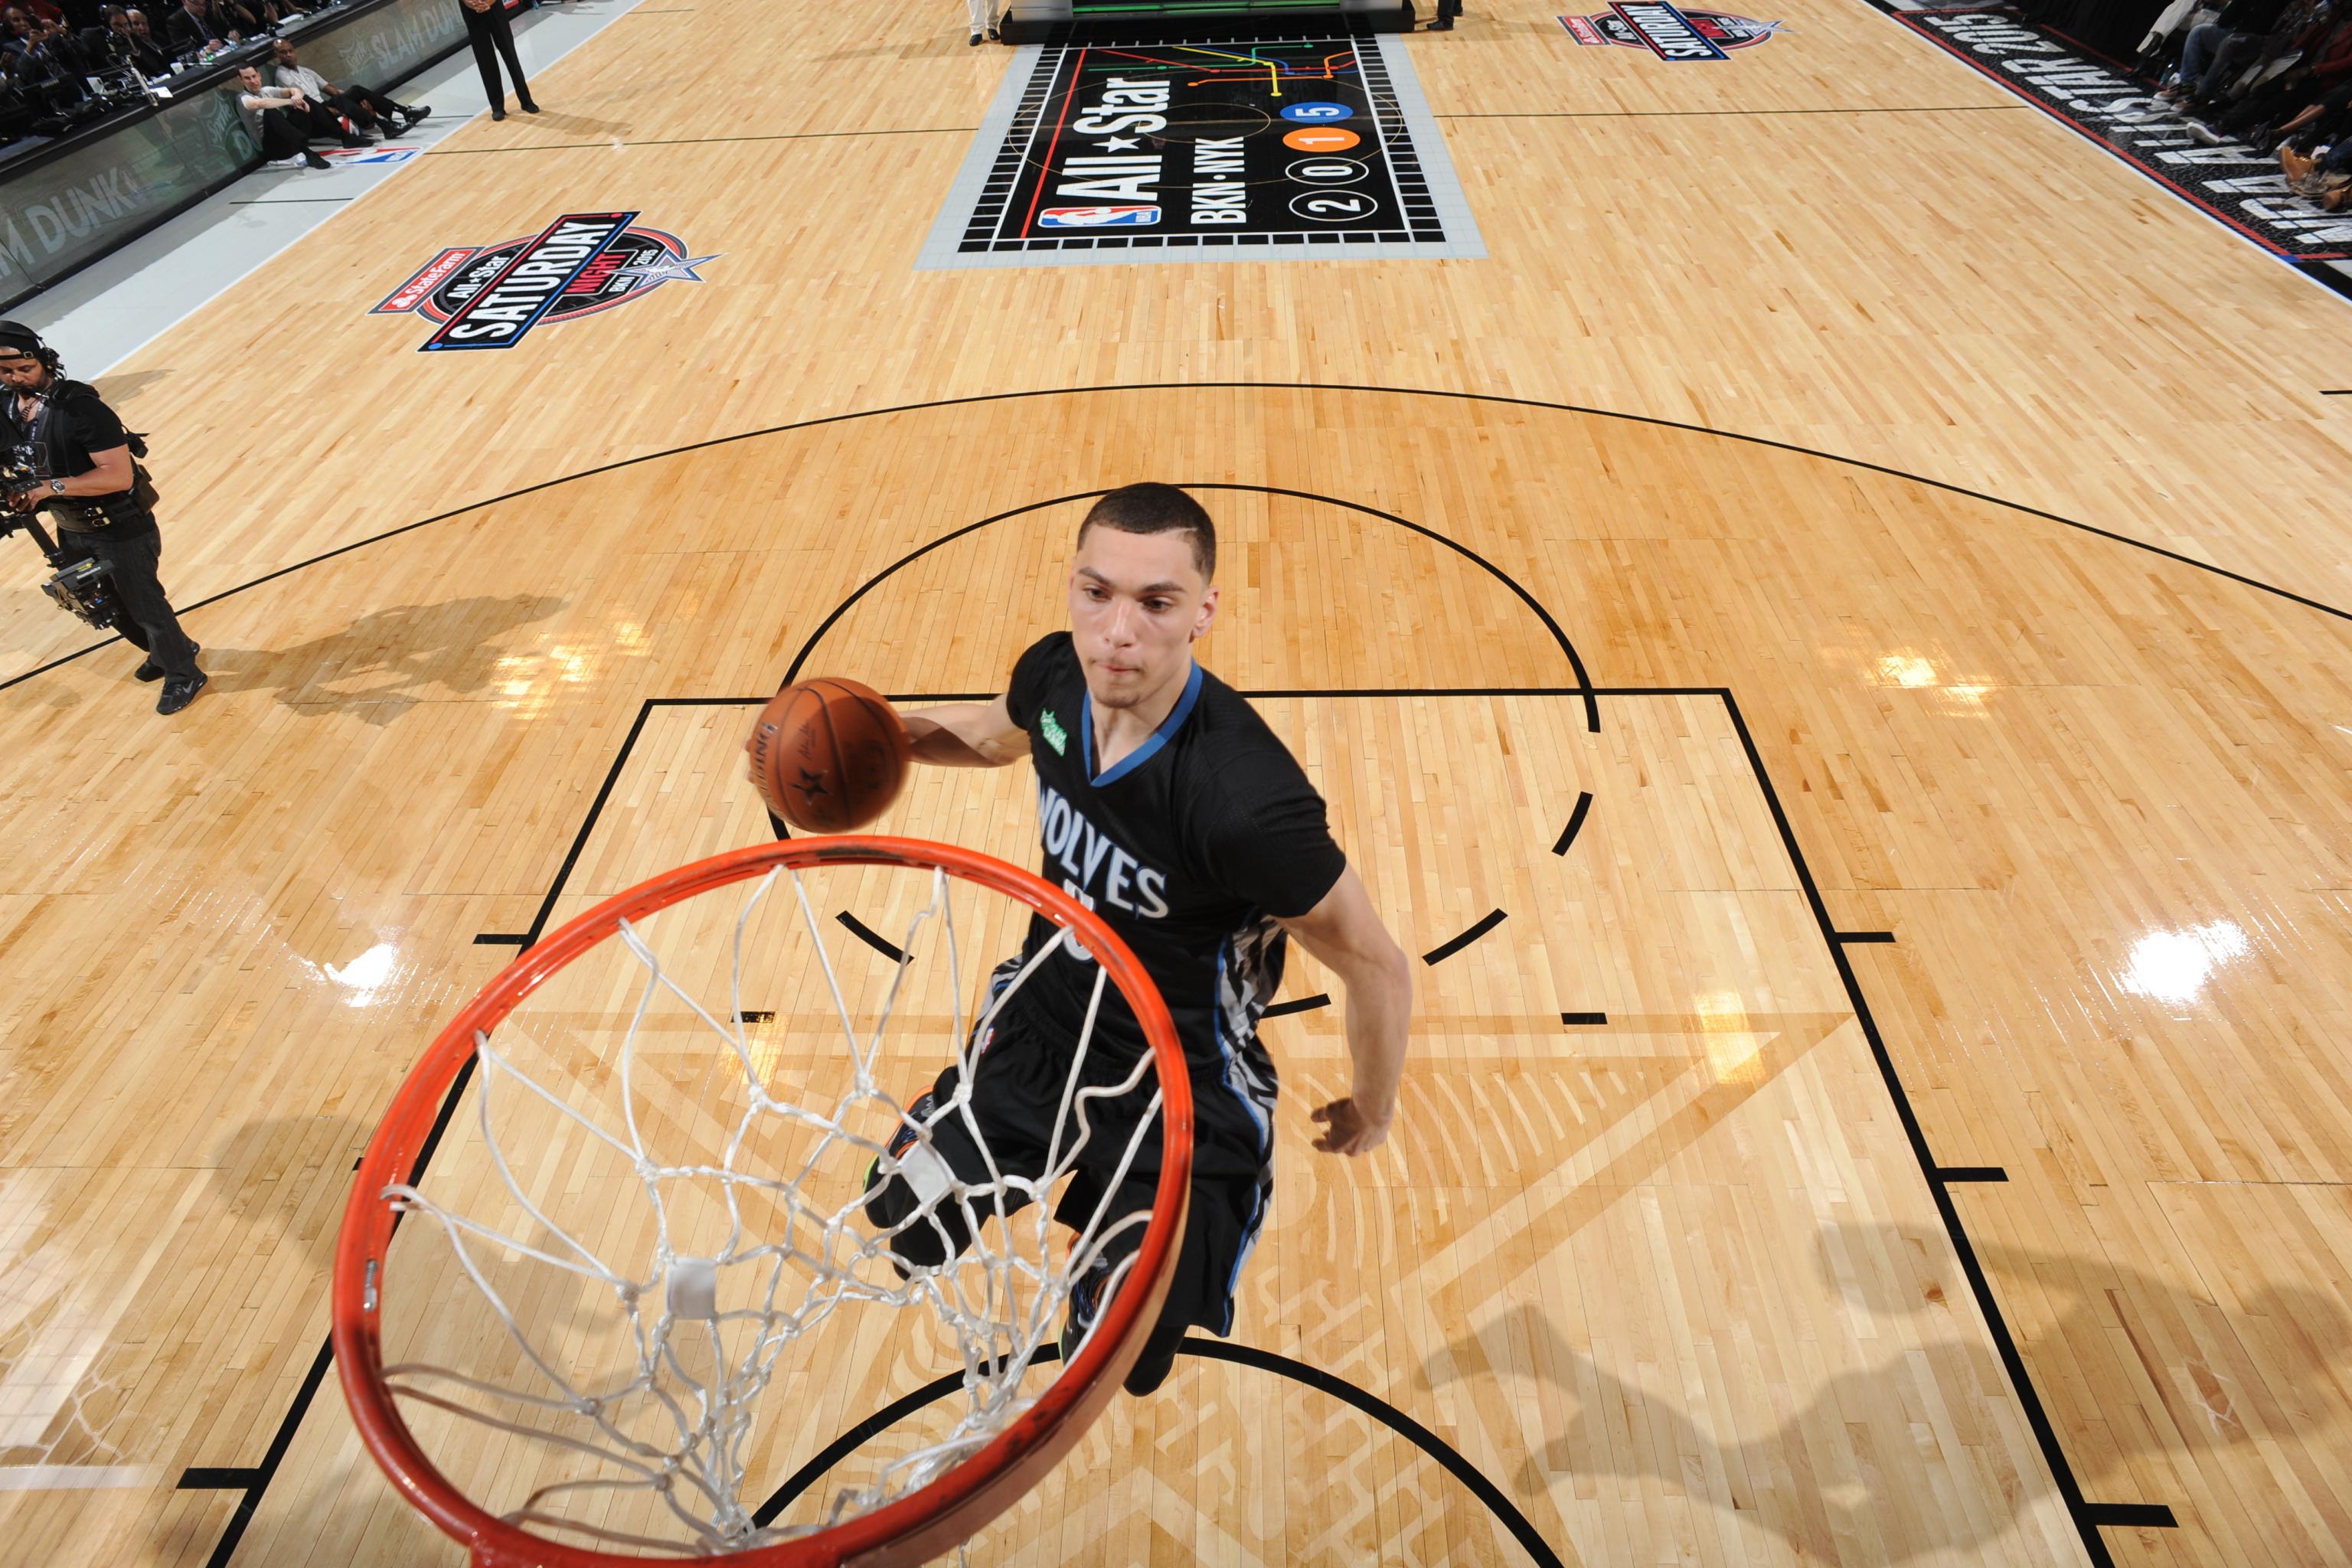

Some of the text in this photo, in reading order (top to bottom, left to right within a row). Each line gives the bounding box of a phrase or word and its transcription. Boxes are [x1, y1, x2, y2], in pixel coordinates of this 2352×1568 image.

[371, 18, 423, 70] SLAM
[421, 0, 464, 39] DUN
[1620, 5, 1713, 57] SATURDAY
[1922, 13, 2066, 55] 2015
[1055, 77, 1171, 202] All Star
[24, 166, 139, 255] DUNK
[449, 221, 617, 338] SATURDAY
[564, 253, 628, 293] NIGHT
[609, 249, 659, 292] BKN 2015
